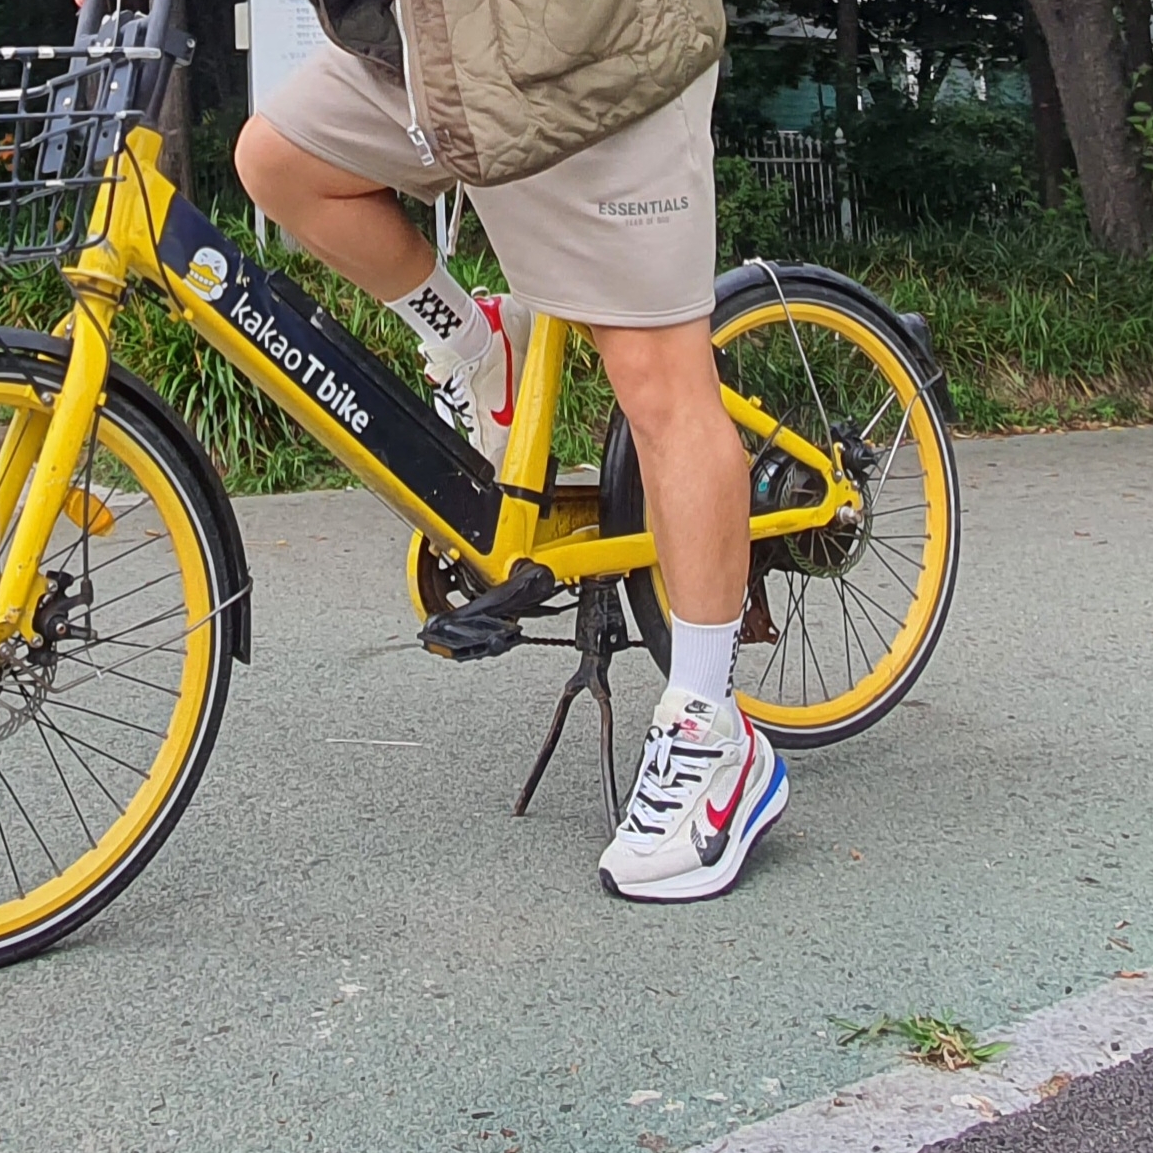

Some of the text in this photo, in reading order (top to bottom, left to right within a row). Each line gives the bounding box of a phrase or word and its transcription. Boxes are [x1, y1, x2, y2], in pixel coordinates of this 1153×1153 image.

[598, 195, 689, 216] ESSENTIALS
[229, 291, 370, 435] kakao T bike
